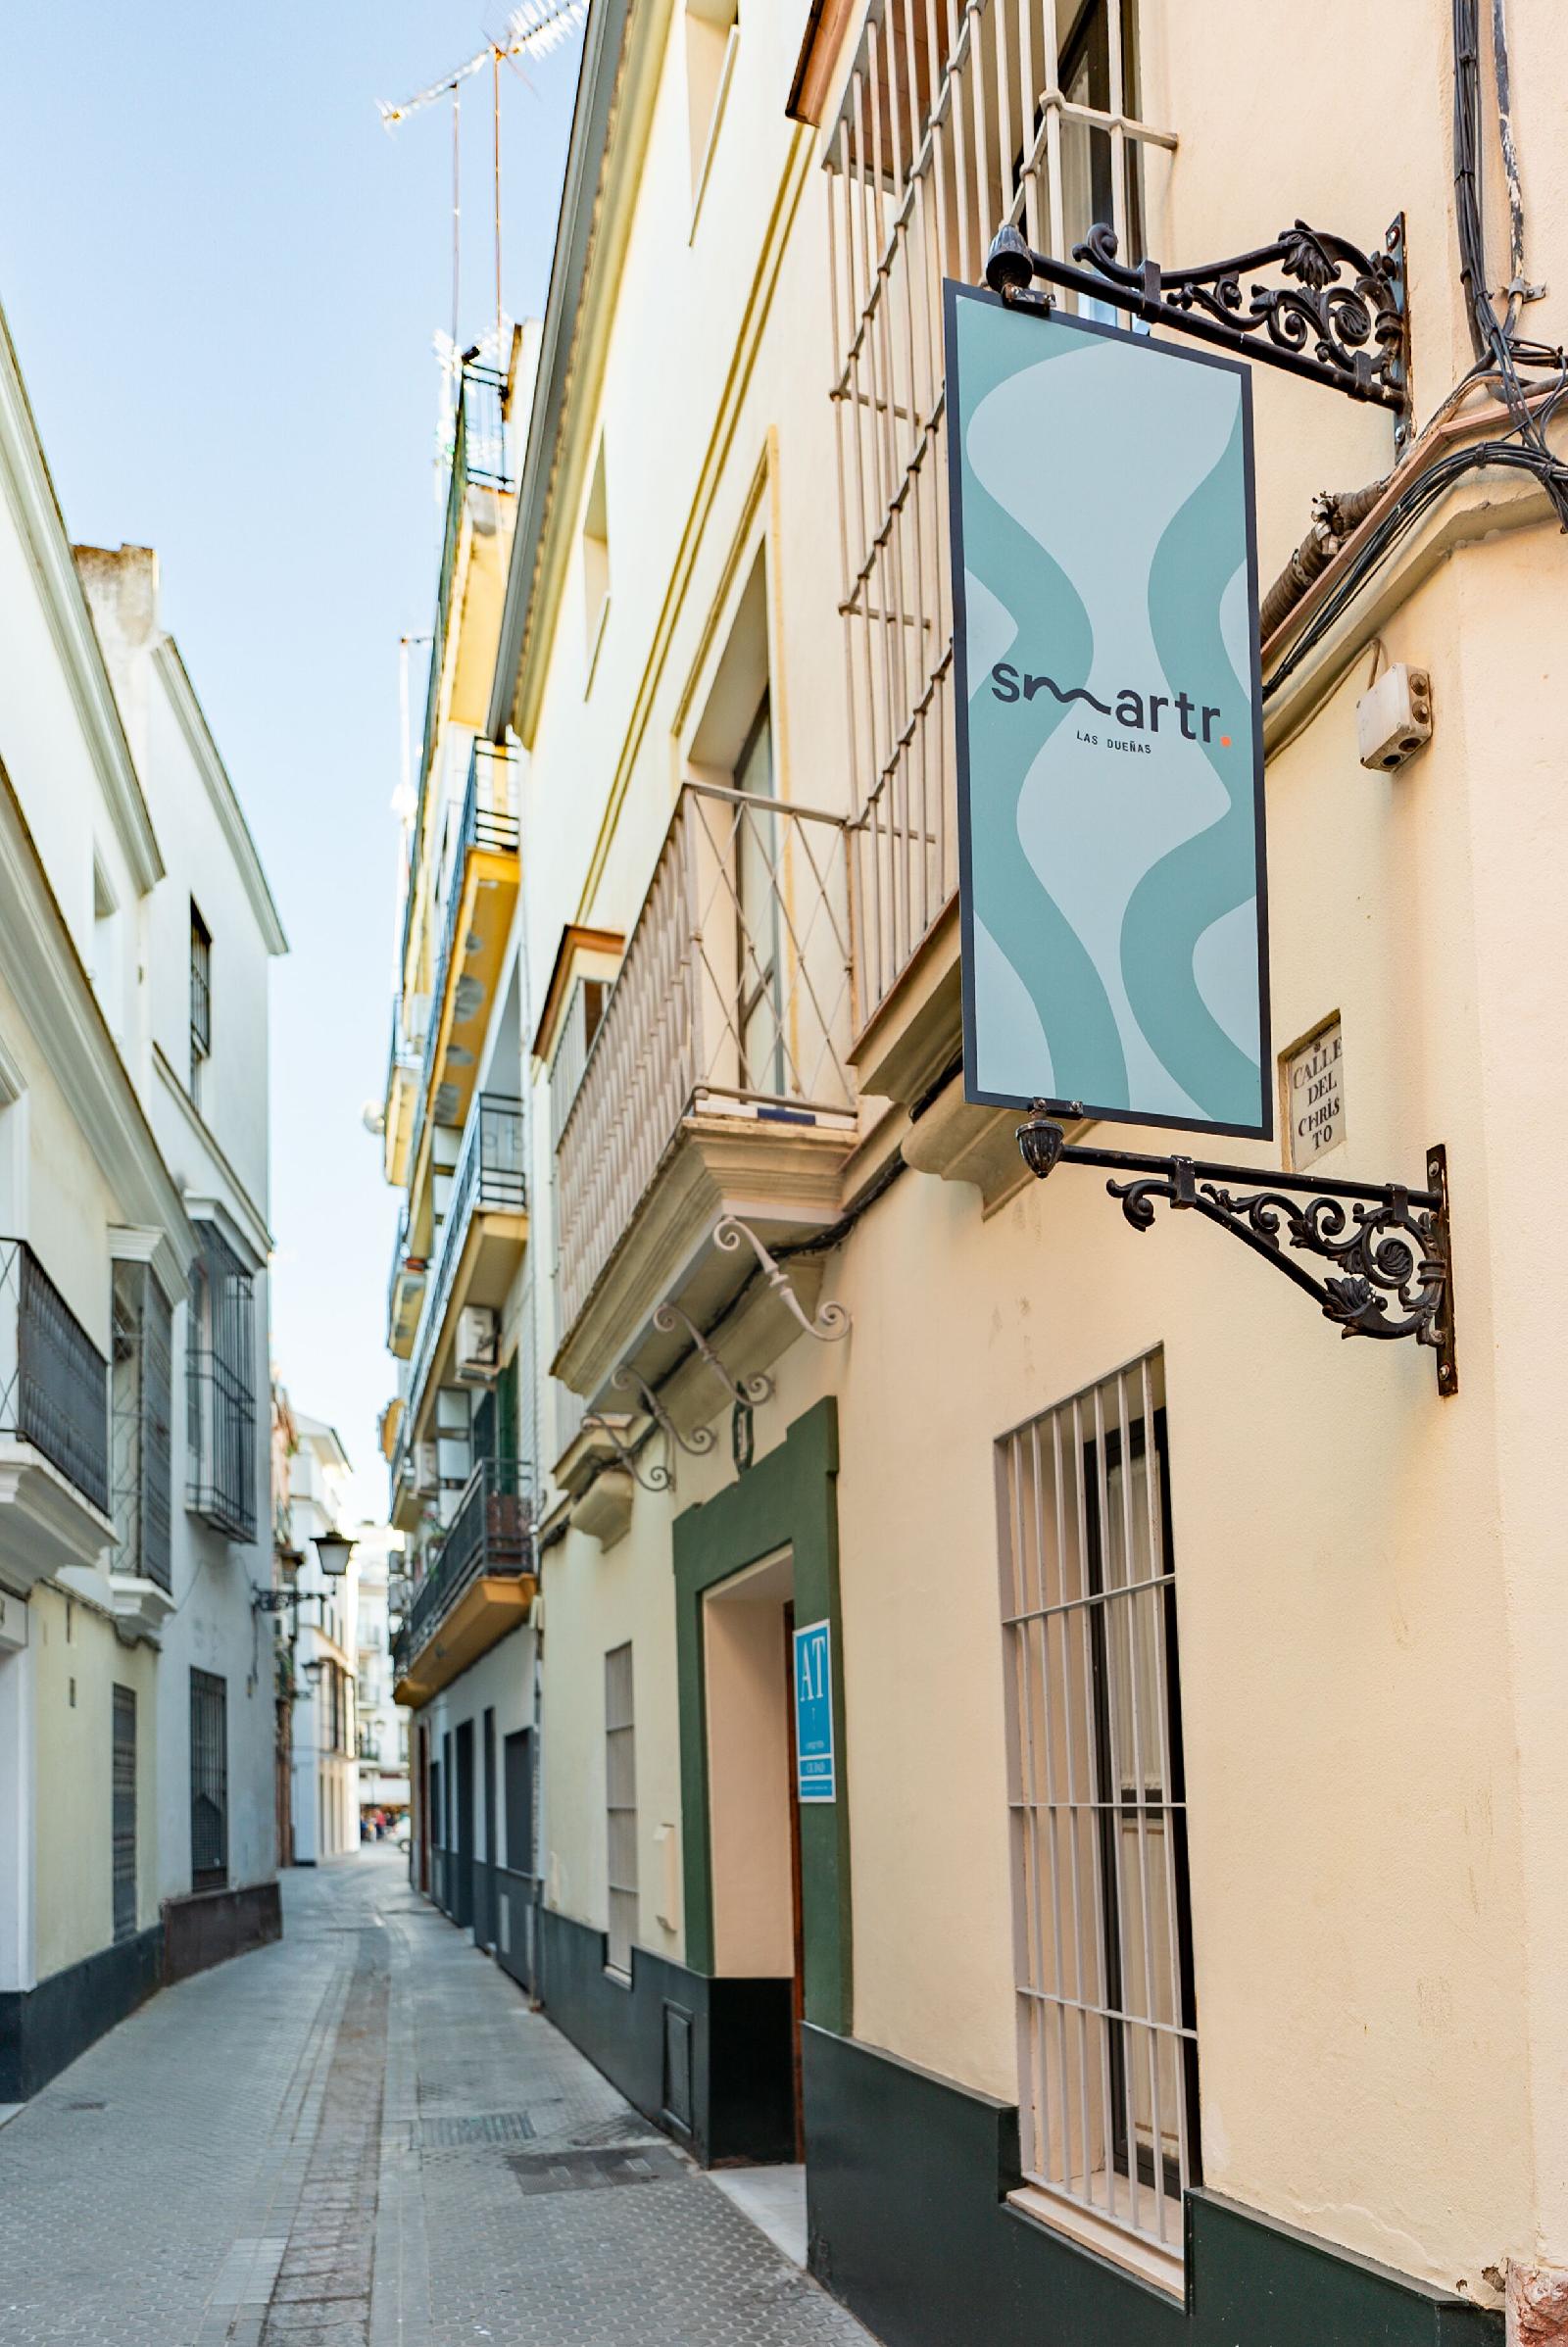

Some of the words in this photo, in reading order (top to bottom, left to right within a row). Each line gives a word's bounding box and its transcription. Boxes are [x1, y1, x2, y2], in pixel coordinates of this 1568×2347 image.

[1076, 730, 1099, 746] LAS
[1106, 738, 1152, 755] DUEÑAS
[1293, 1036, 1343, 1090] CALLE
[1307, 1071, 1337, 1107] DEL
[1312, 1124, 1333, 1150] TO
[800, 1636, 826, 1702] AT
